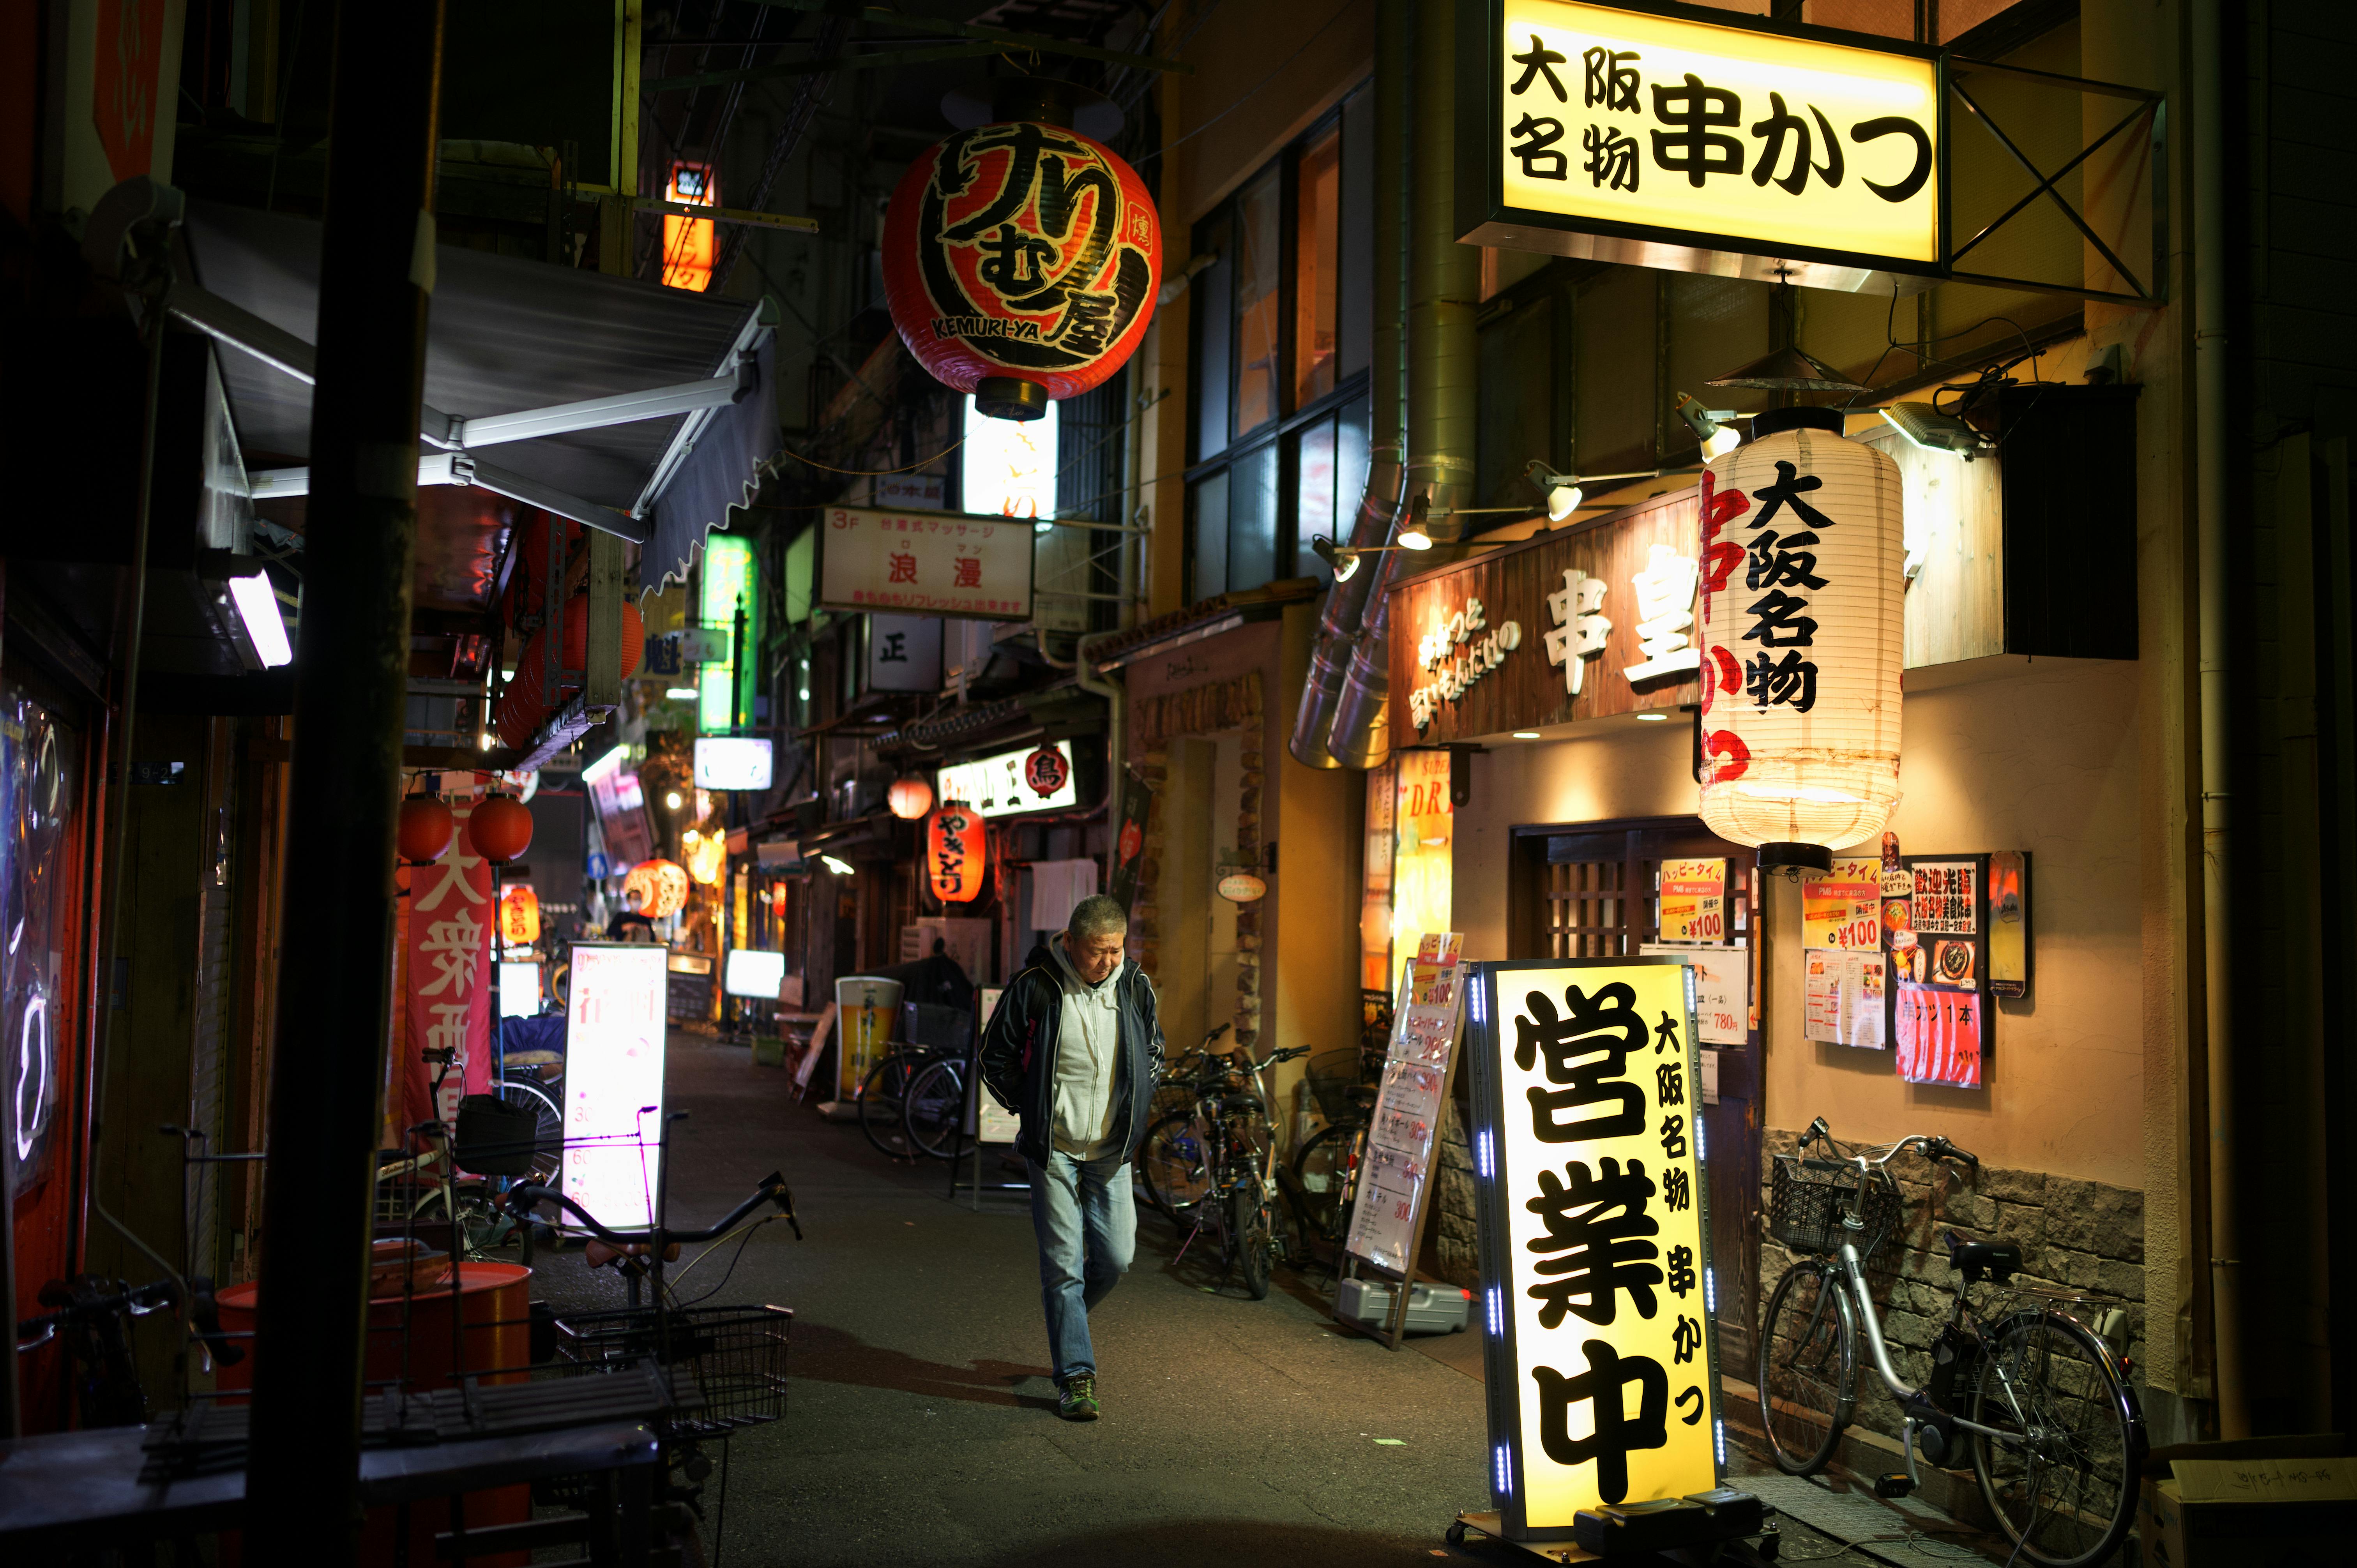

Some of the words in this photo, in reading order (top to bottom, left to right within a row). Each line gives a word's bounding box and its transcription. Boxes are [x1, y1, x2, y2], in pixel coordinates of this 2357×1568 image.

[1510, 34, 1641, 114] 大阪
[1510, 112, 1640, 192] 名物
[1651, 72, 1932, 203] 串かつ
[931, 318, 1040, 340] KEMURI-YA
[832, 511, 860, 530] 3F
[1742, 461, 1837, 715] 大阪名物
[879, 632, 907, 663] 正
[1663, 862, 1721, 883] ハッピータイム
[1689, 913, 1721, 939] ¥100
[1838, 920, 1877, 948] ¥100
[1654, 1010, 1690, 1213] 大阪名物
[1514, 982, 1668, 1504] 営業中
[1667, 1245, 1704, 1426] 串かつ
